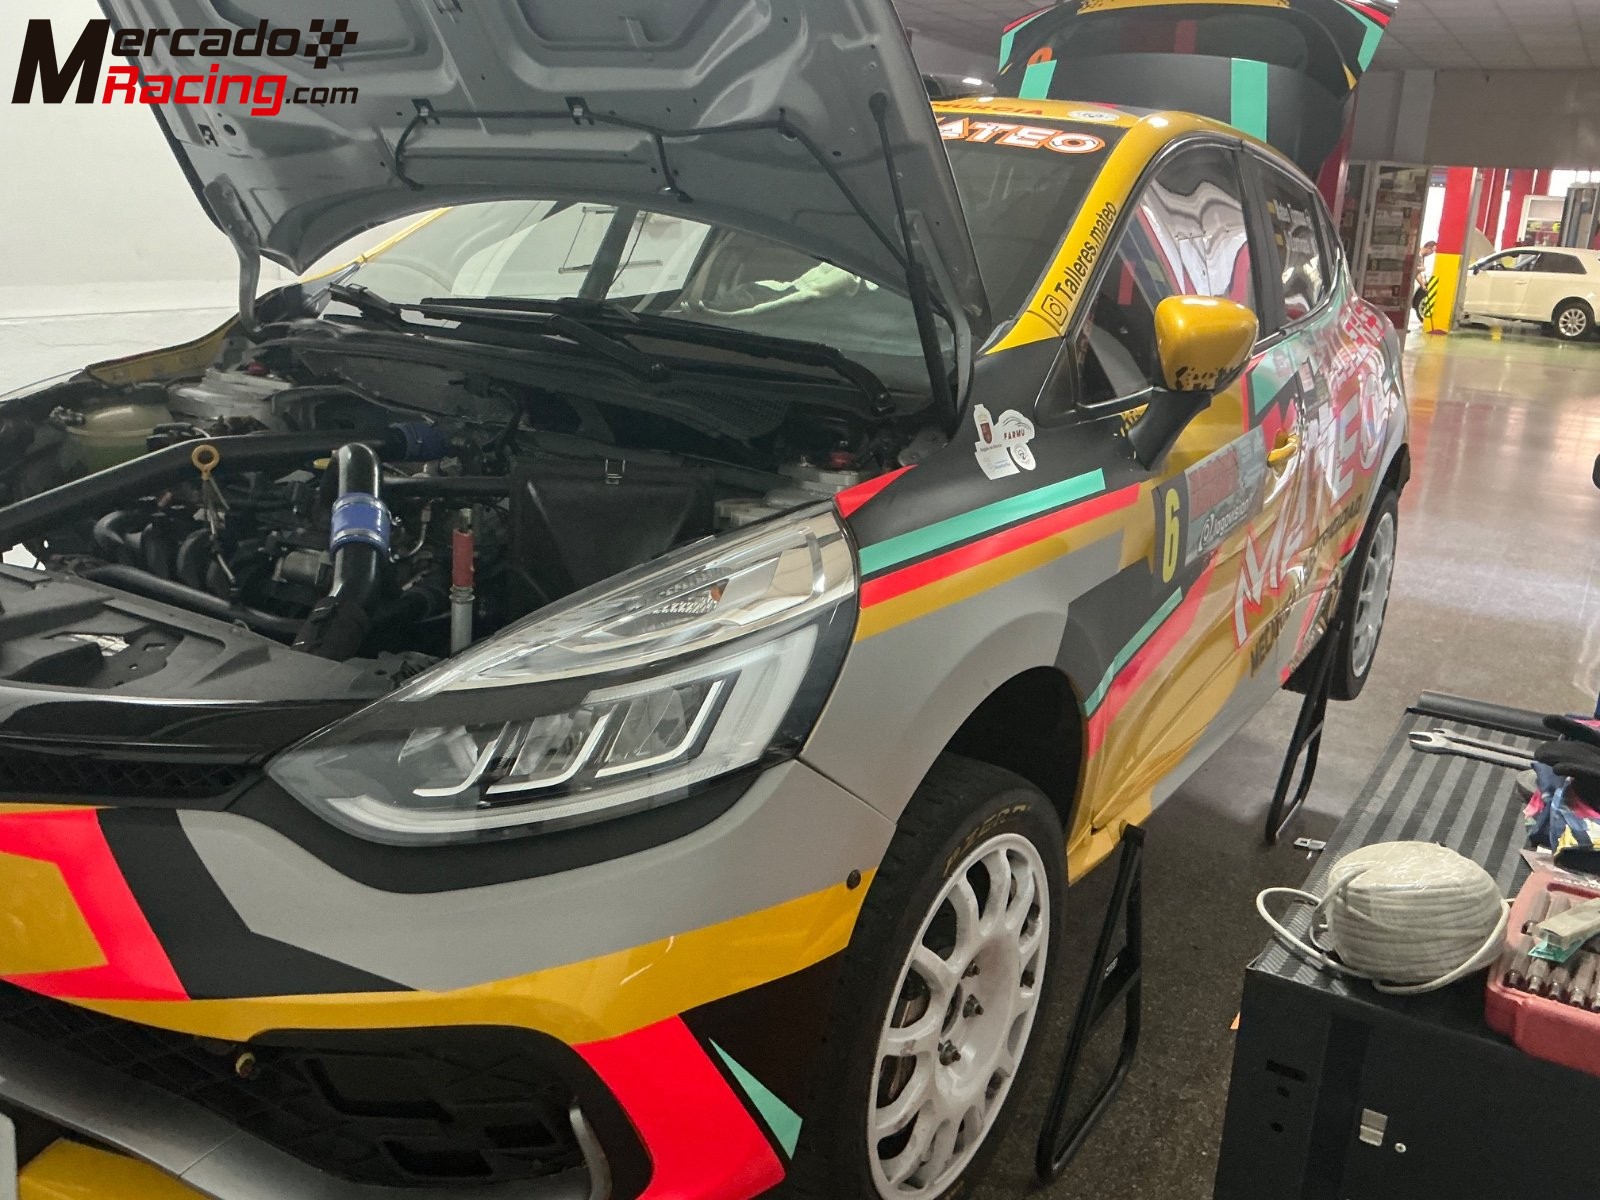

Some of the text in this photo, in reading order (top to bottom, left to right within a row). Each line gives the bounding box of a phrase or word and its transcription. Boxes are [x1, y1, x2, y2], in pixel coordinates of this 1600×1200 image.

[937, 116, 1106, 154] ATEO
[1053, 201, 1118, 302] Talleres.mateo
[1162, 487, 1181, 584] 6
